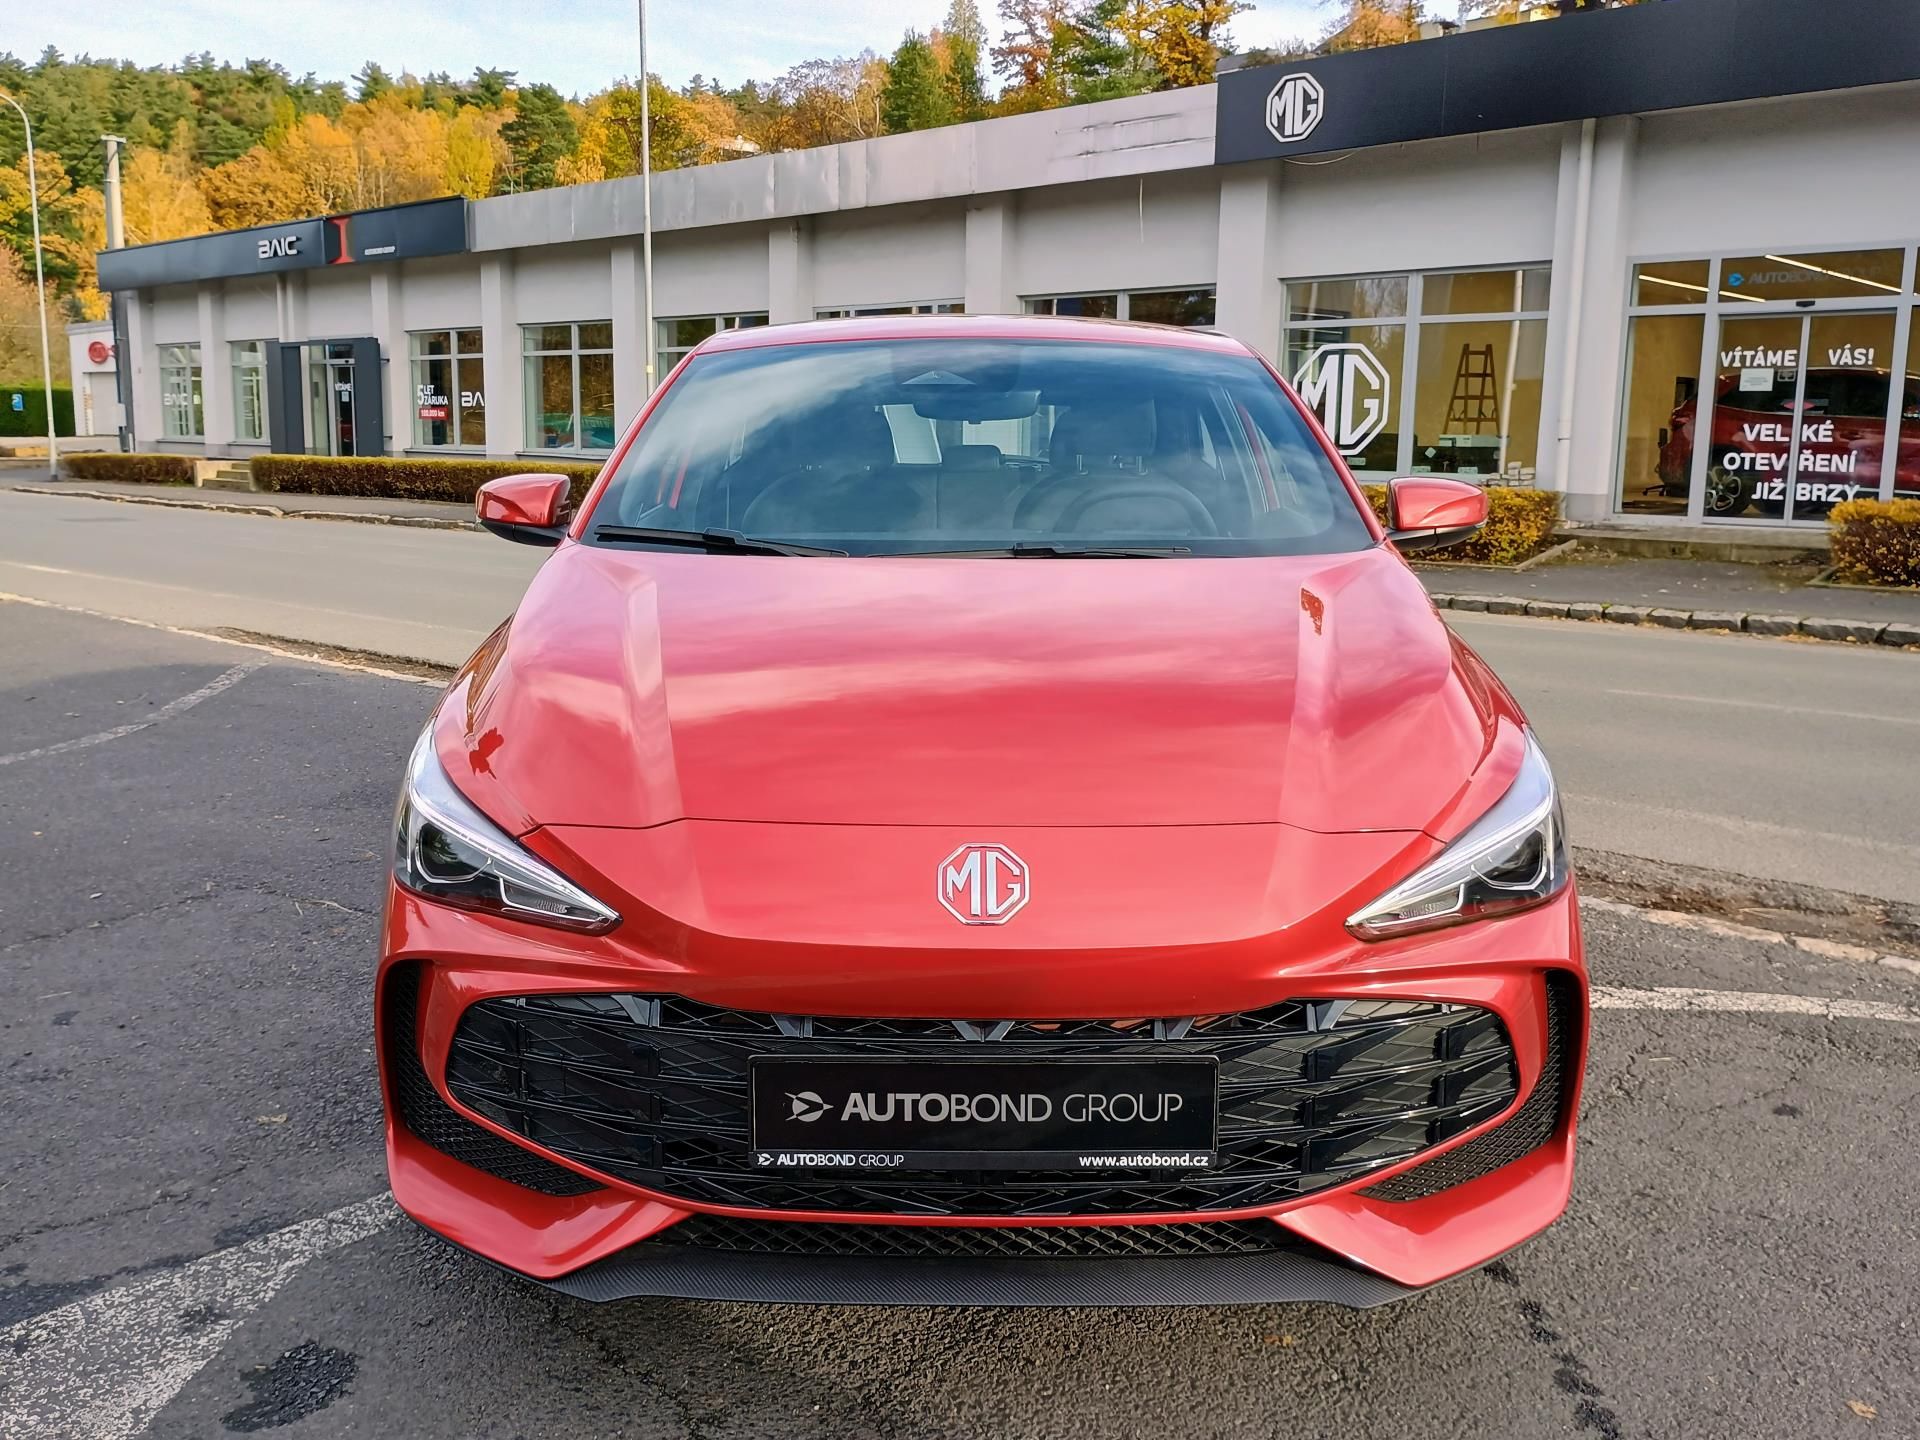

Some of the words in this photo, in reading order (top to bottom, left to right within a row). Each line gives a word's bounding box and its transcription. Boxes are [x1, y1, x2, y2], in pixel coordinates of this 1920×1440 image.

[1270, 78, 1319, 136] MG
[257, 235, 299, 259] BAIC
[1720, 345, 1798, 367] VÍTÁME
[1827, 343, 1876, 367] VÁS!
[417, 384, 425, 406] 5
[424, 385, 434, 394] LET
[1300, 353, 1381, 446] MG
[1751, 477, 1785, 501] JIŽ
[1795, 481, 1861, 503] BRZY
[945, 849, 1021, 917] MG
[840, 1092, 1053, 1122] AUTOBOND
[1062, 1093, 1183, 1122] GROUP
[777, 1153, 856, 1167] AUTOBOND
[858, 1154, 905, 1167] GROUP
[1079, 1152, 1209, 1167] www.autobond.cz
